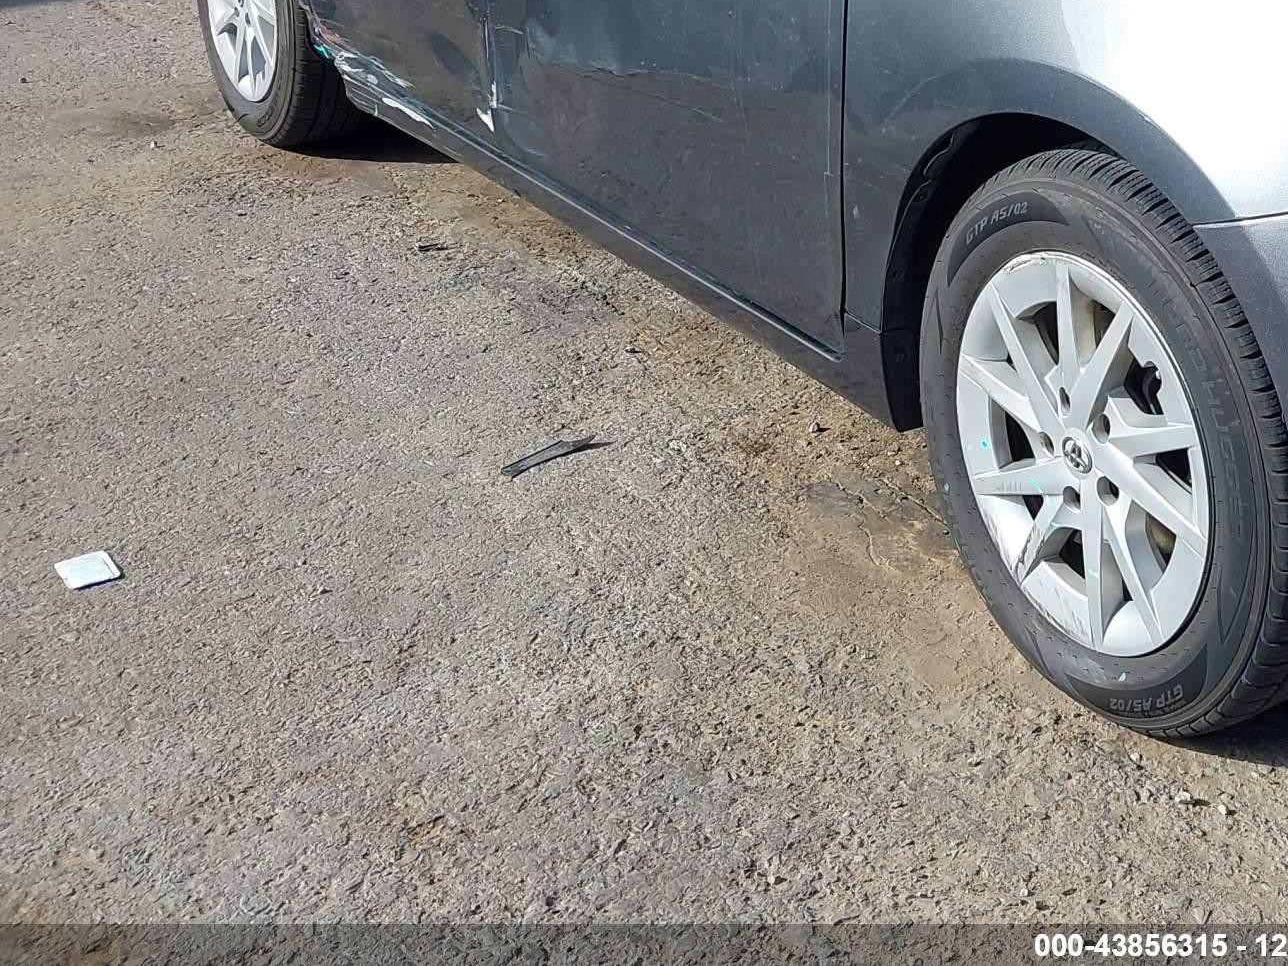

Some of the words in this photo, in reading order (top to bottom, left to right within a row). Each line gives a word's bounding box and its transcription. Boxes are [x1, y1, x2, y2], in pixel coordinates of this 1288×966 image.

[965, 215, 989, 245] GTP
[991, 201, 1028, 225] AS/02
[1156, 684, 1184, 708] GTP
